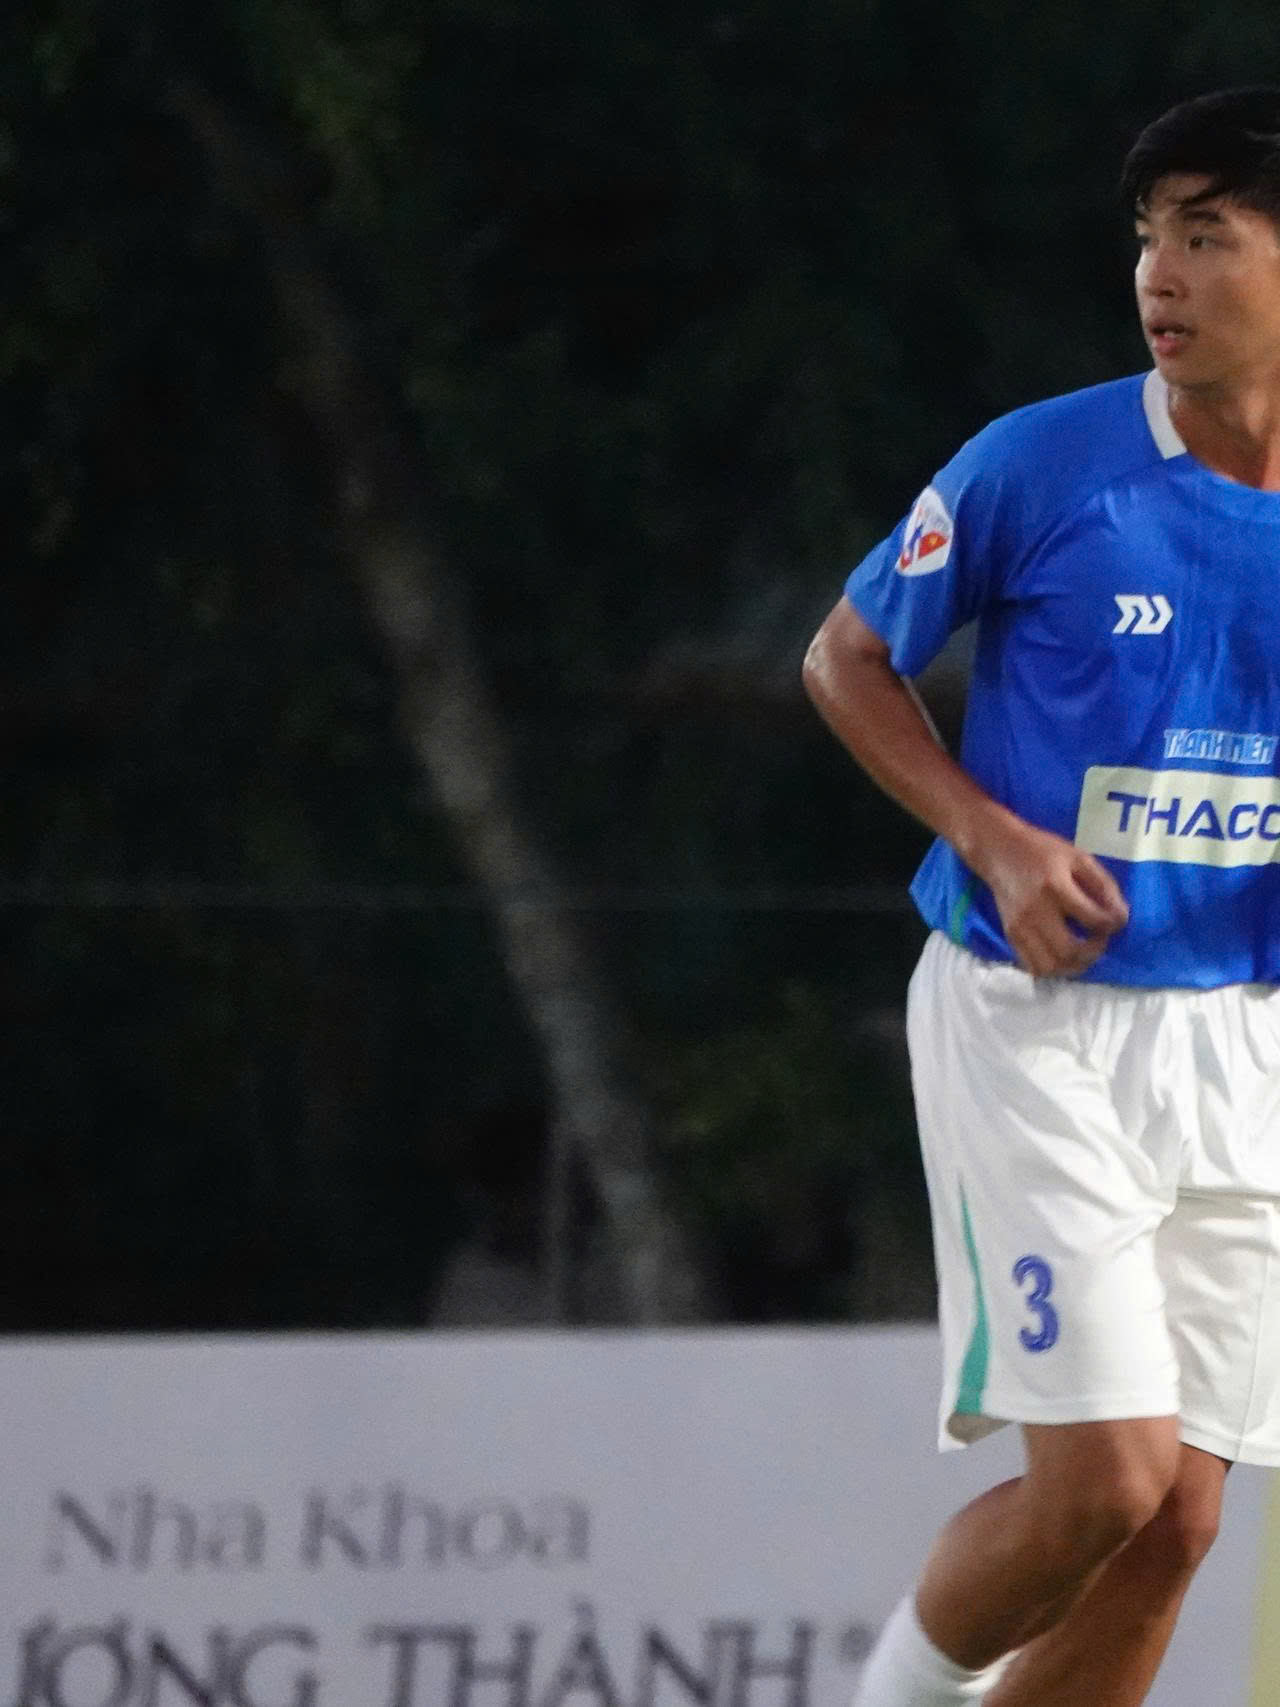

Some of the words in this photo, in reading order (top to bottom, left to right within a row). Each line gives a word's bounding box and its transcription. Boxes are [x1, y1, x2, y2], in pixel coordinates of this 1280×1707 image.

[1012, 1254, 1060, 1353] 3
[45, 1488, 267, 1572] Nha
[302, 1484, 593, 1572] Khoa
[362, 1597, 816, 1707] THÀNH
